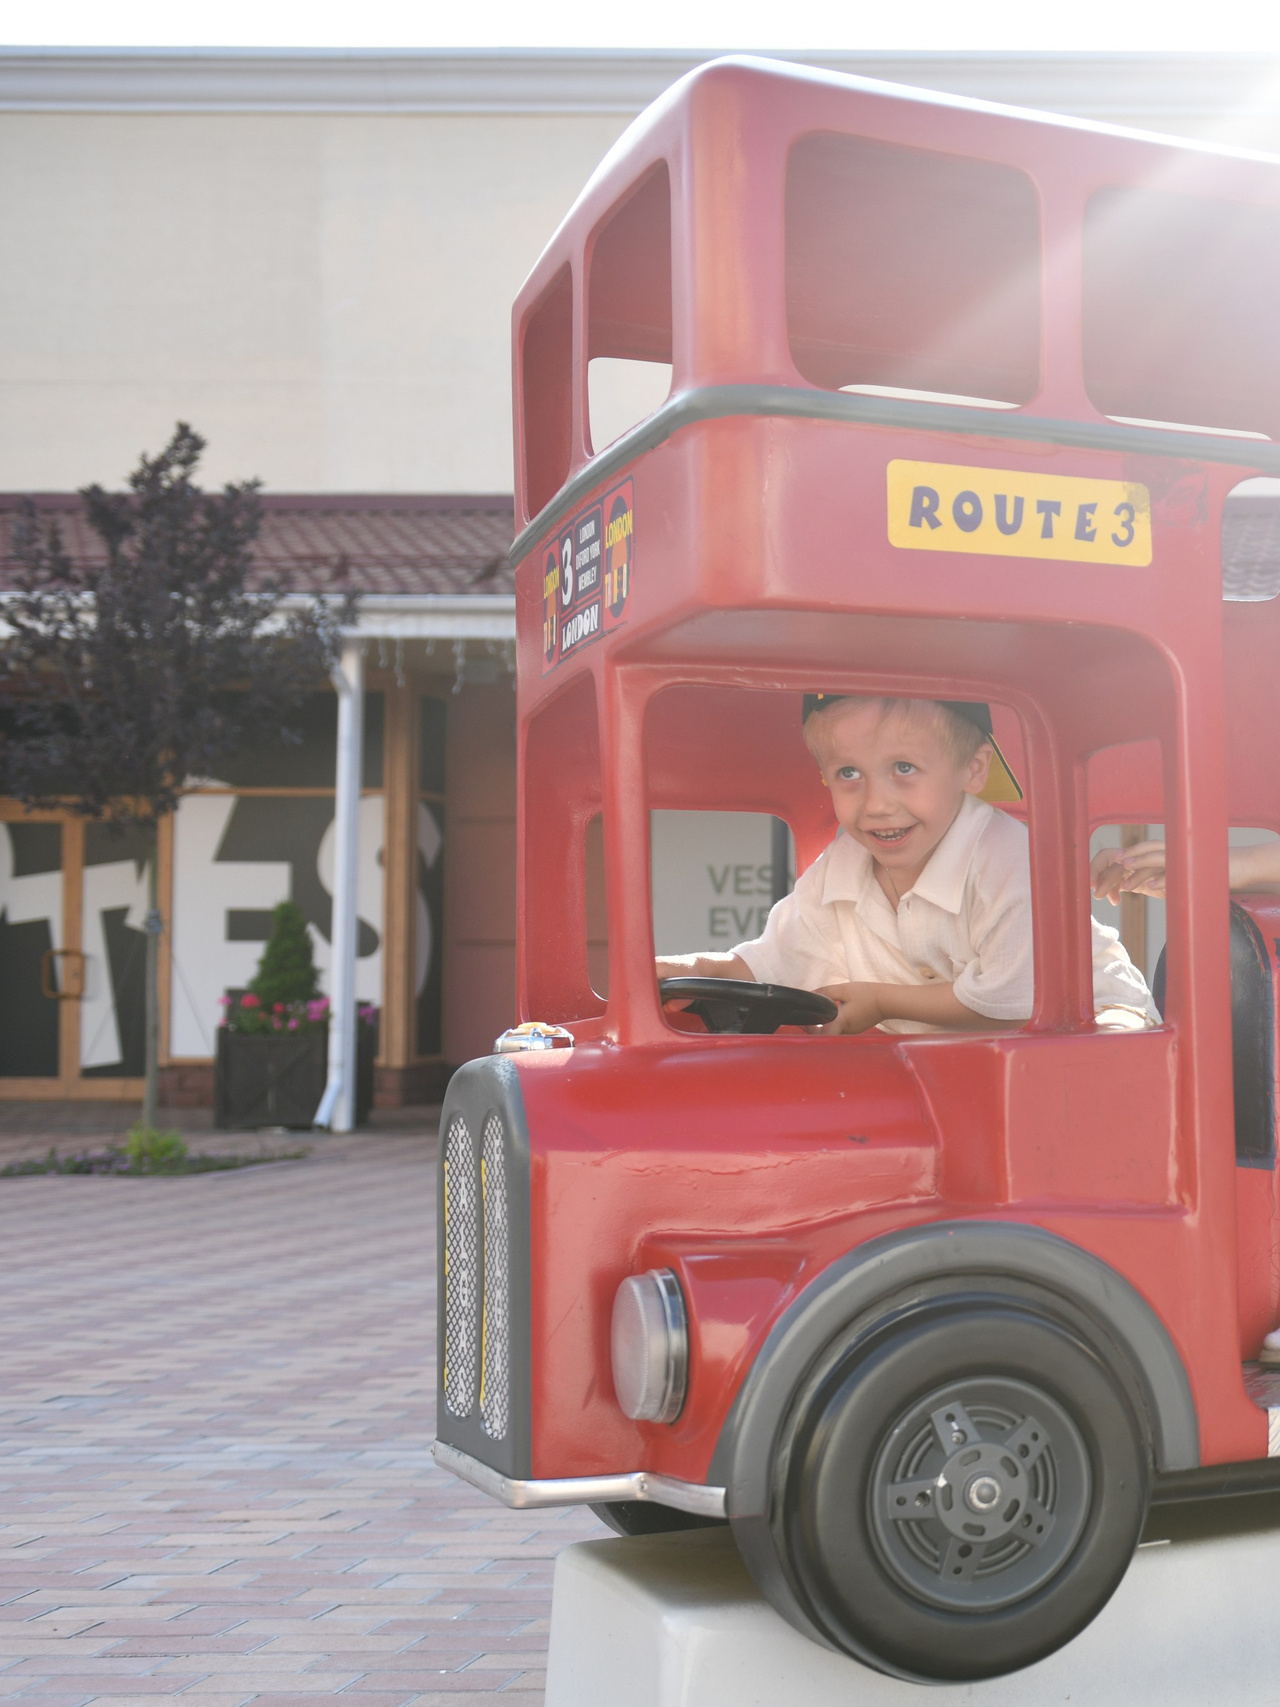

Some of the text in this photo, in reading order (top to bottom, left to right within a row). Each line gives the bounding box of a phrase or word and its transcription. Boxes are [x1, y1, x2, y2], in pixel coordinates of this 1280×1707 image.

[579, 519, 595, 544] LONDON
[605, 509, 633, 549] LONDON
[908, 485, 1135, 547] ROUTE 3
[543, 565, 560, 599] LONDON
[561, 537, 573, 606] 3
[578, 565, 597, 592] WEMBLEY
[561, 604, 599, 652] LONDON
